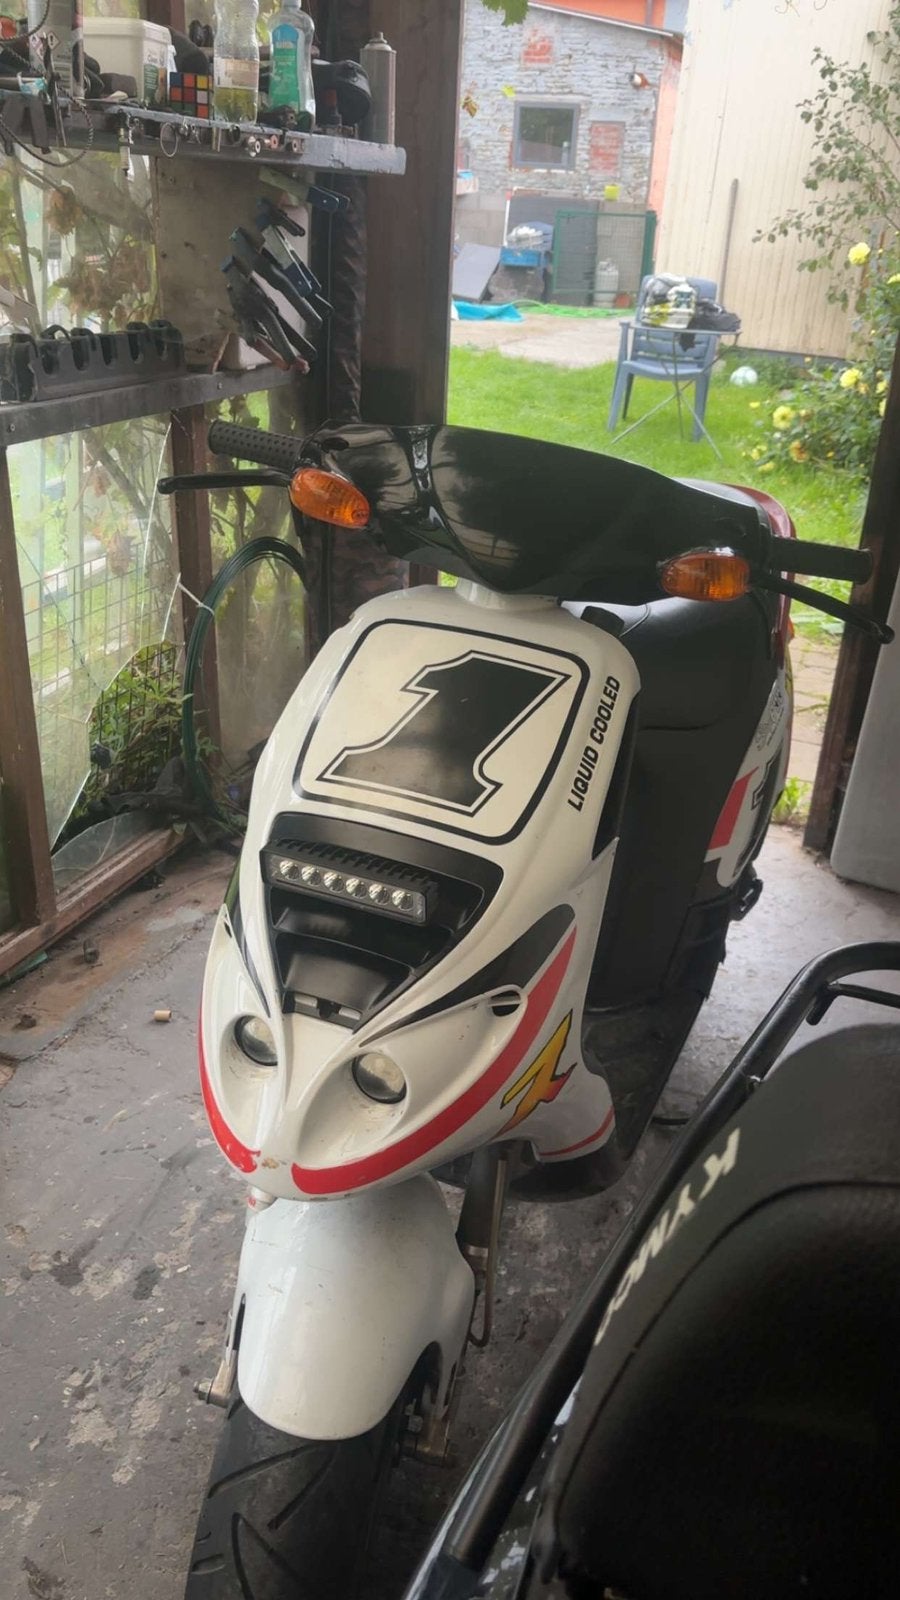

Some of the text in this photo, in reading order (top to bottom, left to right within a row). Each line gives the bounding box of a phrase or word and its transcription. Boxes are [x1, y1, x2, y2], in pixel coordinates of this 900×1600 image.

[315, 649, 573, 818] 1
[567, 675, 621, 812] LIQUID COOLED
